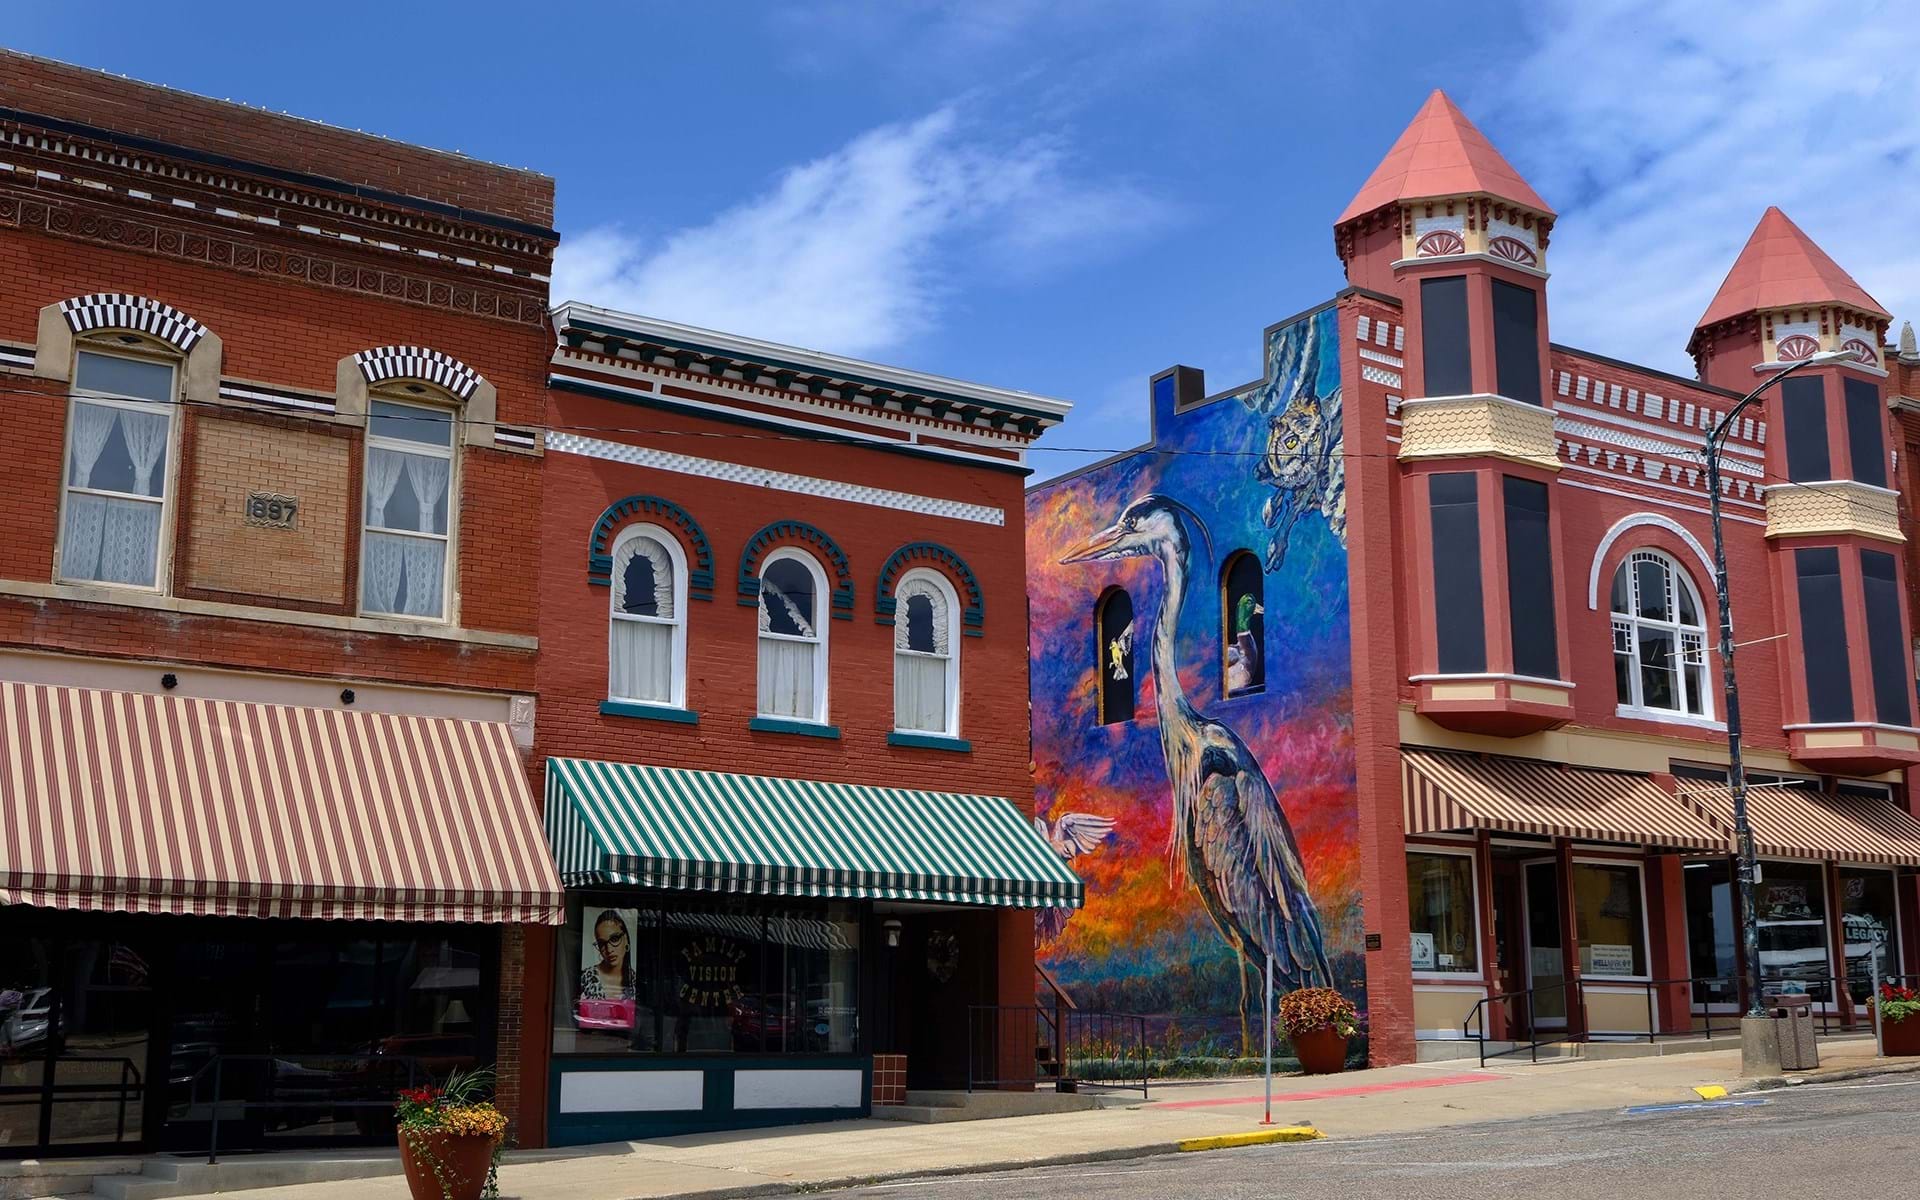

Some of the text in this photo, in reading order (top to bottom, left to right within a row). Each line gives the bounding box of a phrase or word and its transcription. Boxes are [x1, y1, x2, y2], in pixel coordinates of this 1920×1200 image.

[246, 498, 297, 522] 1897
[1845, 927, 1889, 942] LEGACY
[681, 936, 746, 963] FAMILY
[689, 965, 737, 982] VISION
[679, 983, 745, 1007] CENTER
